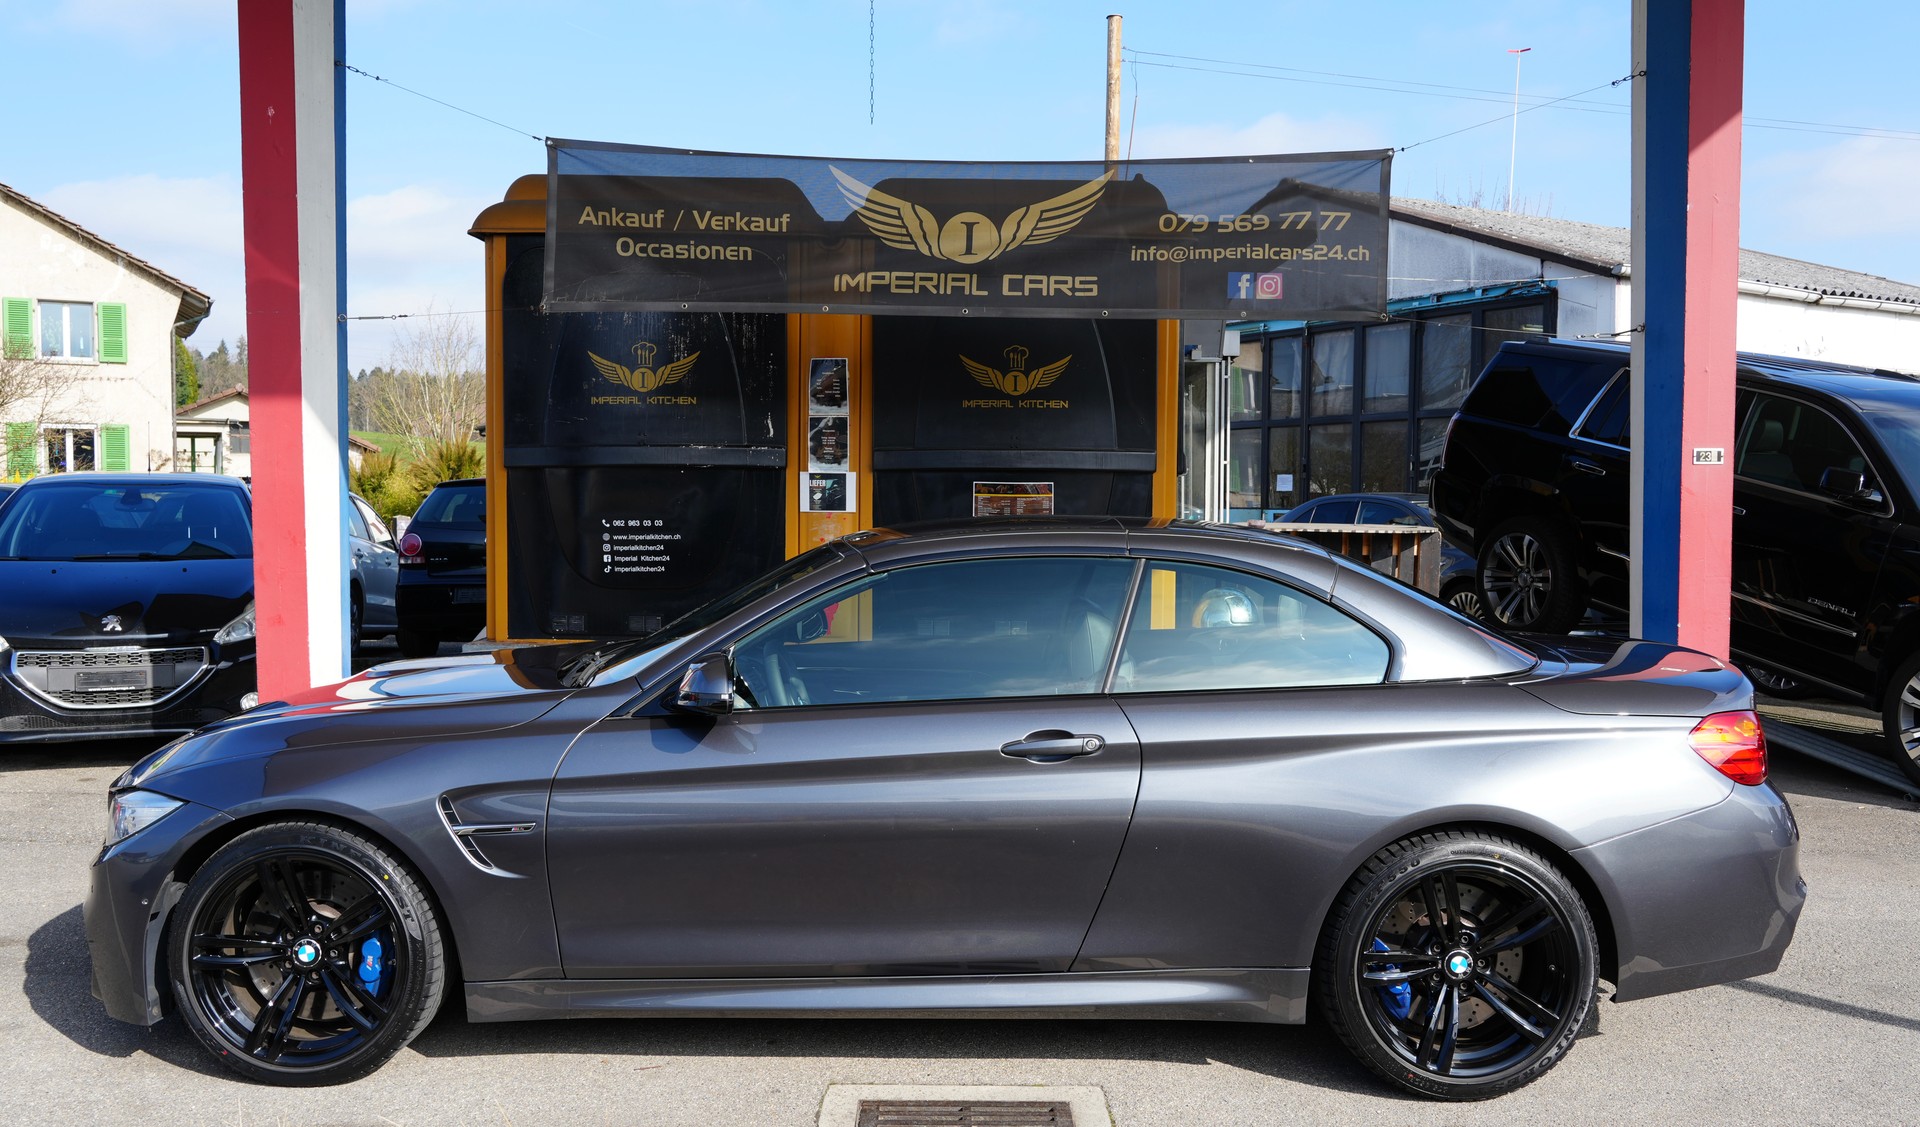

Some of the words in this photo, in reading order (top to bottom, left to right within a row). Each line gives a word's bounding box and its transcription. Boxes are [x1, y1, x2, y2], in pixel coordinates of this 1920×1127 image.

[578, 206, 665, 229] Ankauf
[673, 209, 684, 232] /
[692, 210, 791, 233] Verkauf
[1158, 213, 1209, 233] 079
[1217, 213, 1270, 233] 569
[1279, 211, 1312, 230] 77
[1320, 211, 1351, 231] 77
[615, 237, 753, 261] Occasionen
[1130, 243, 1370, 263] info@imperialcars24.ch
[833, 271, 989, 296] IMPERIAL
[1002, 274, 1098, 297] CARS
[590, 396, 642, 405] IMPERIAL
[646, 396, 697, 405] KITCHEN
[962, 399, 1014, 408] IMPERIAL
[1018, 399, 1069, 409] KITCHEN
[1699, 451, 1712, 462] 23
[1807, 596, 1857, 617] DENALI
